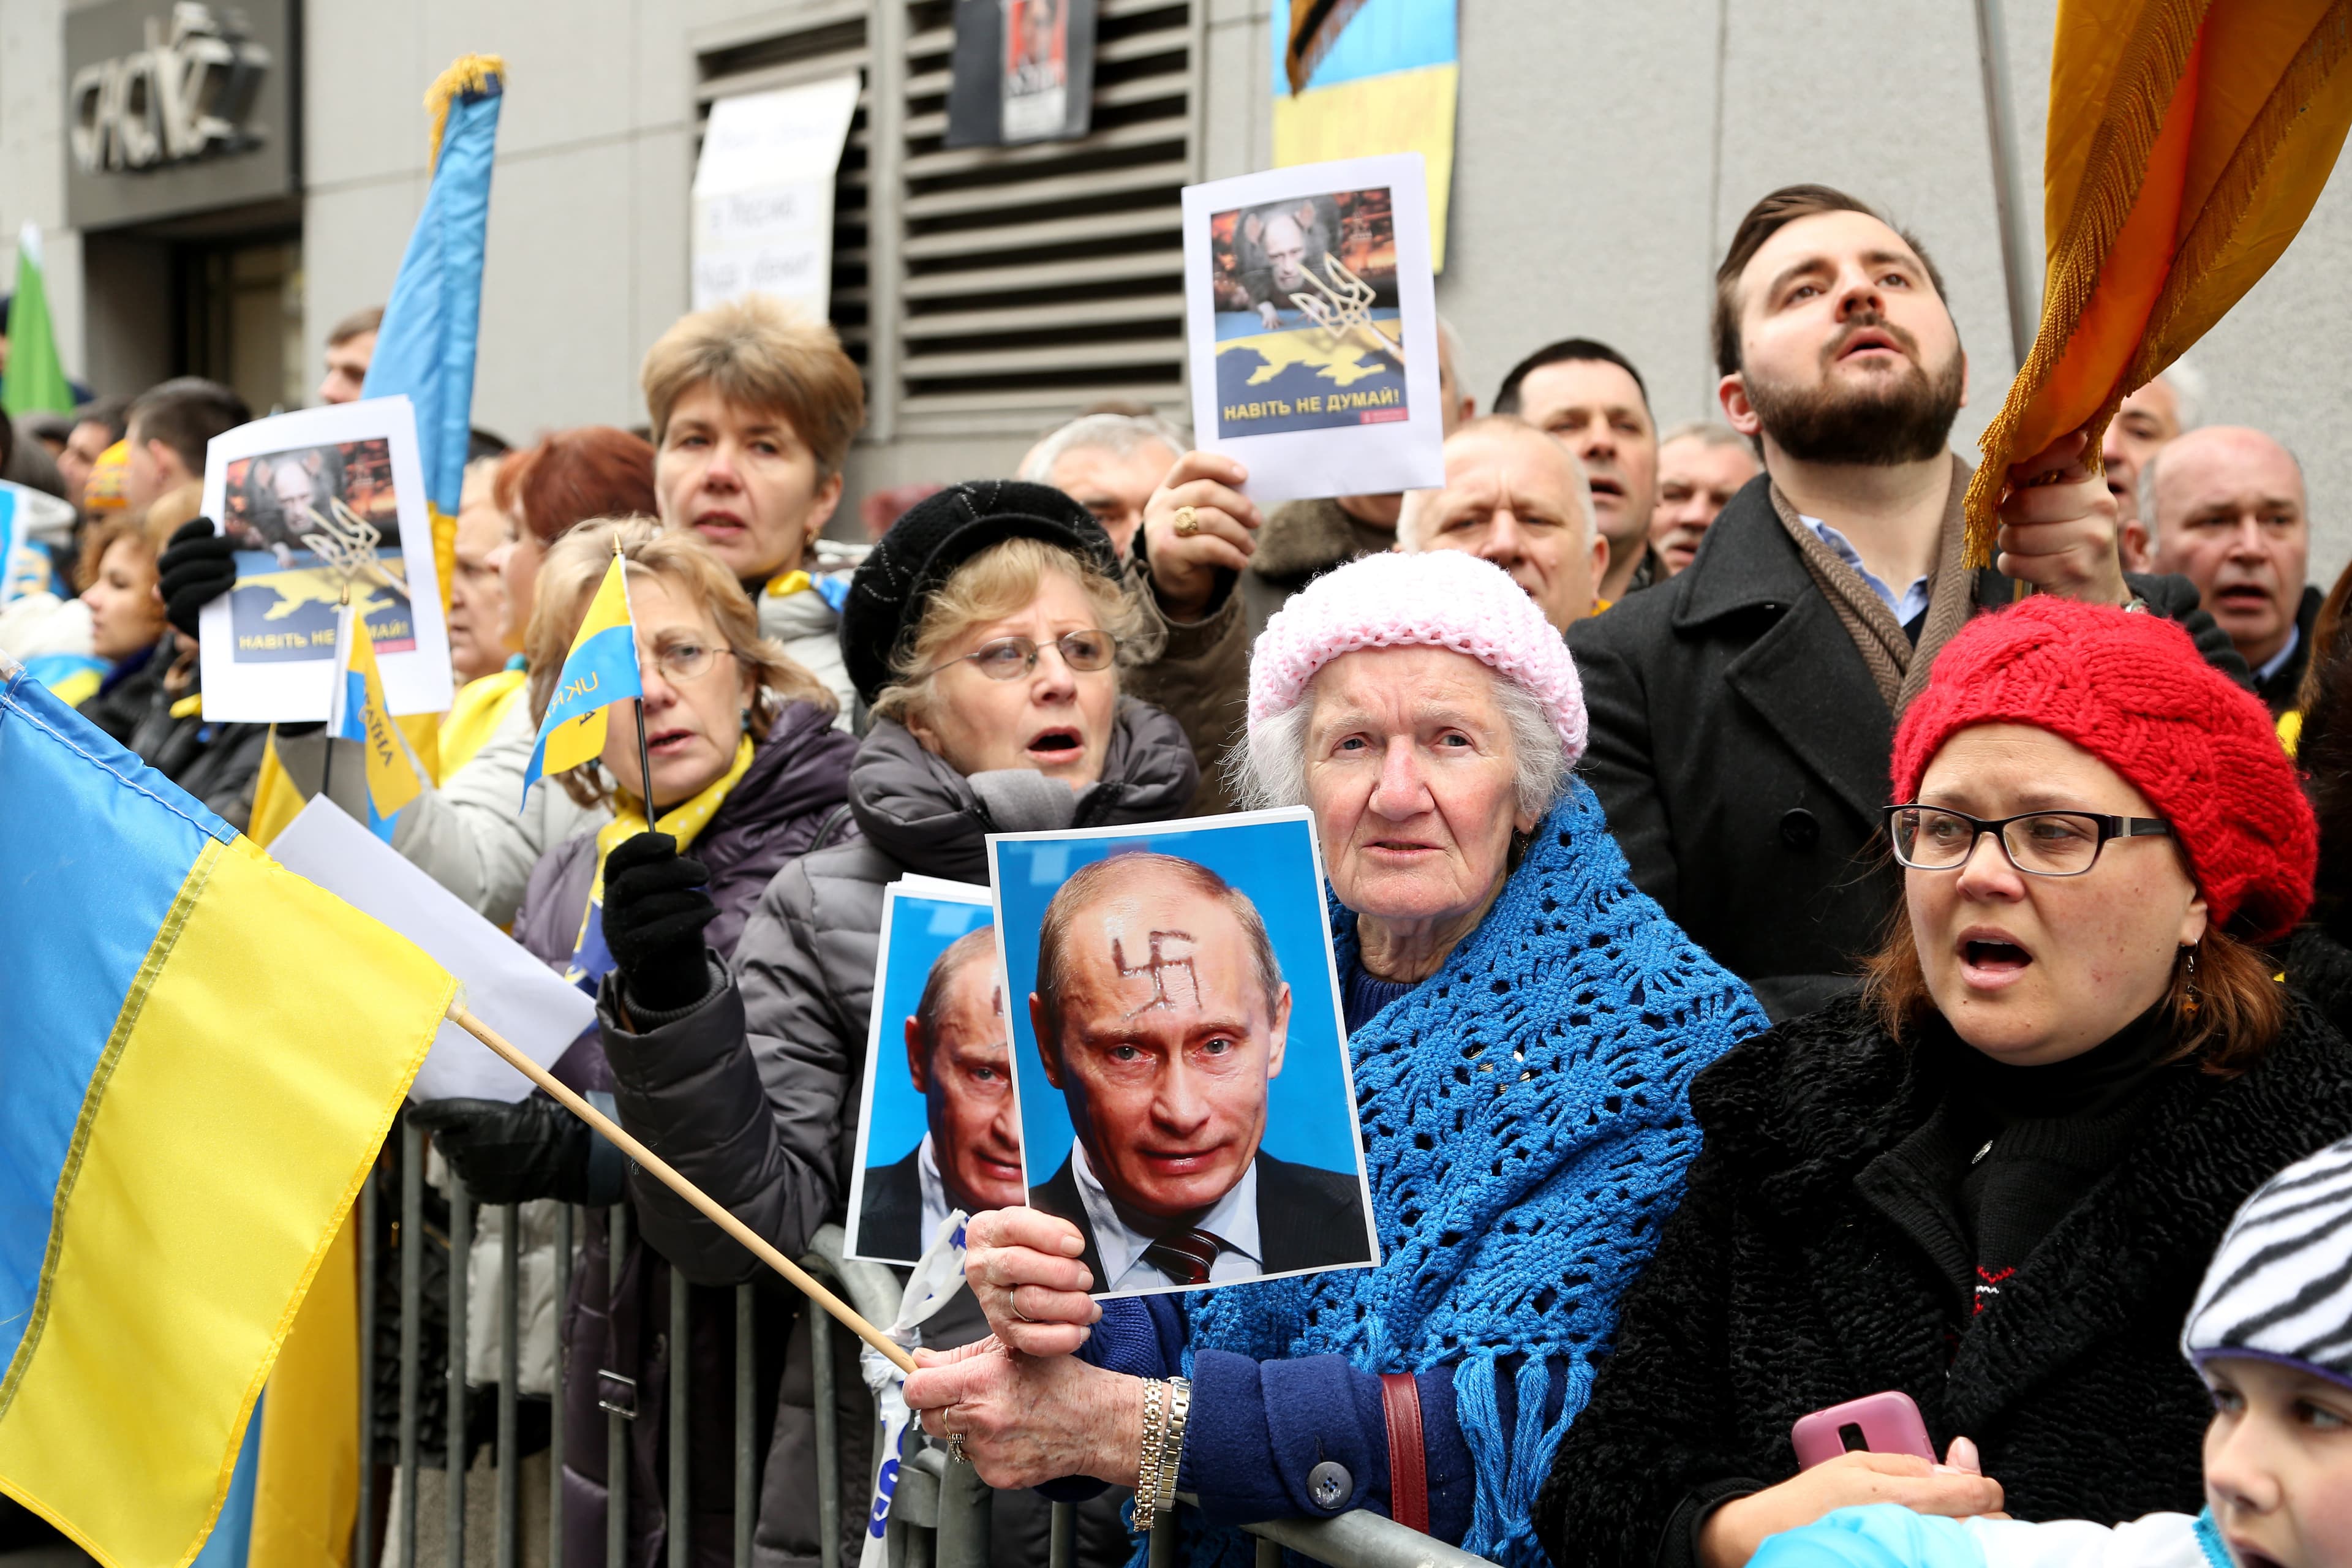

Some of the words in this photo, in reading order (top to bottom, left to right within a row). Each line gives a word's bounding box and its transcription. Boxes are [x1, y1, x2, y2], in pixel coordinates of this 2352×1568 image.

[1223, 400, 1291, 421] НАВІТЬ
[1295, 396, 1321, 414] НЕ
[1326, 386, 1400, 412] ДУМАЙ!
[239, 633, 307, 650] НАВІТЬ
[311, 628, 335, 646] НЕ
